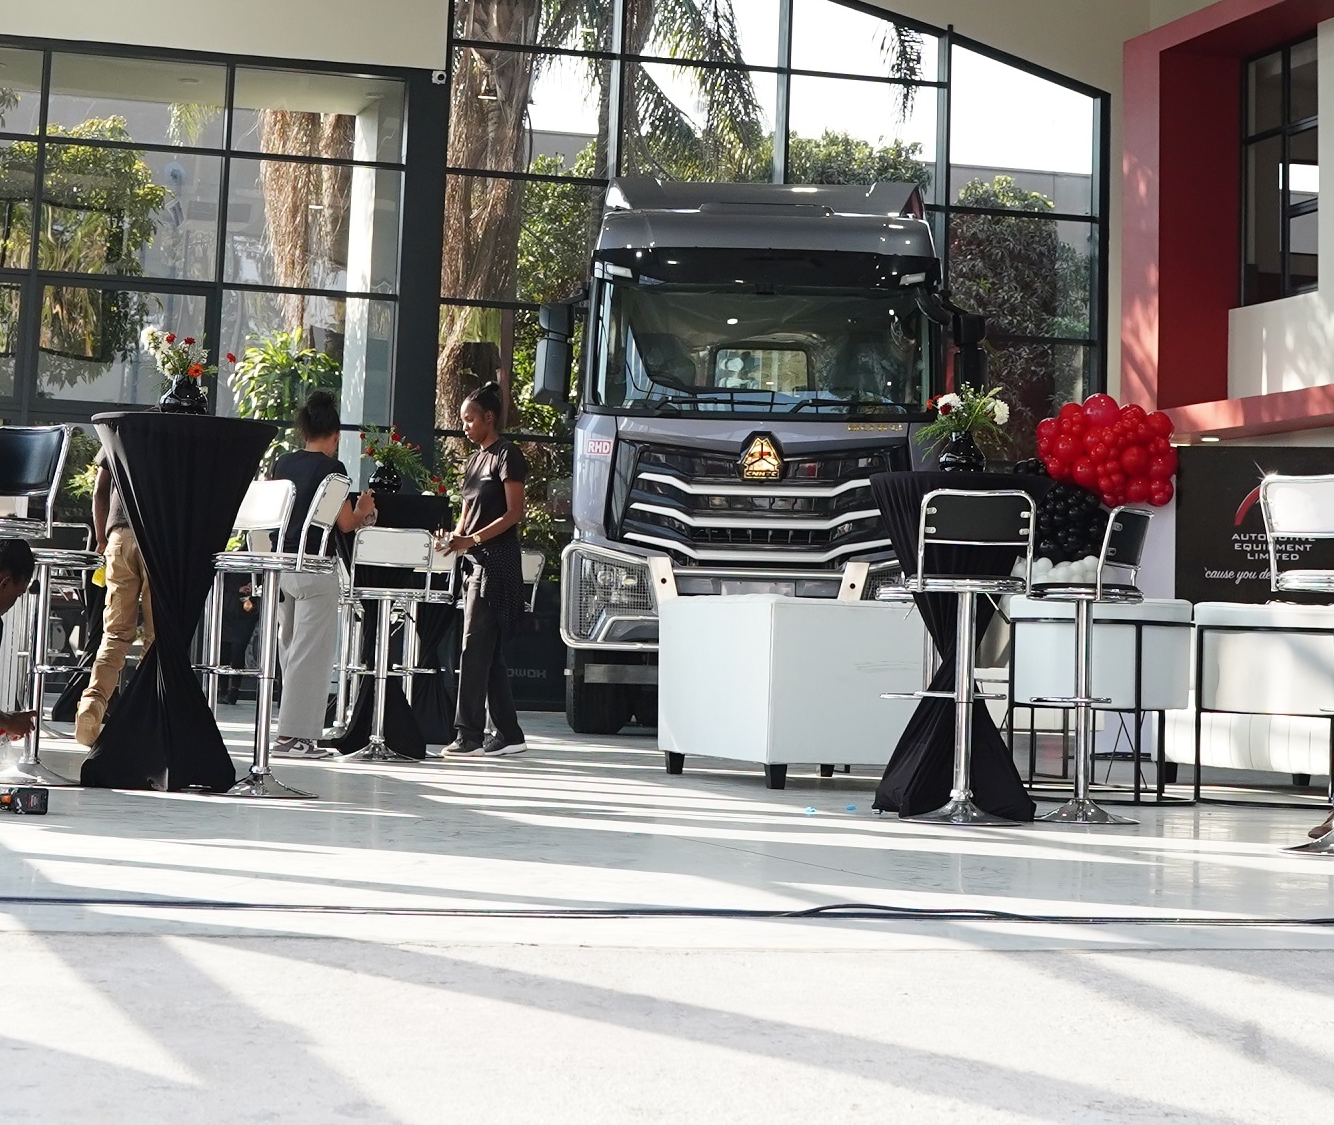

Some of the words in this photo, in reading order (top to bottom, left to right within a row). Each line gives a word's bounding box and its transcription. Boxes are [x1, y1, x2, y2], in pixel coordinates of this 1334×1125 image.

[587, 440, 611, 454] RHD
[1231, 533, 1316, 542] AUTOOTIVE
[1234, 543, 1313, 551] EQUIMENT
[1247, 553, 1300, 561] LIMTED
[1236, 571, 1258, 585] you
